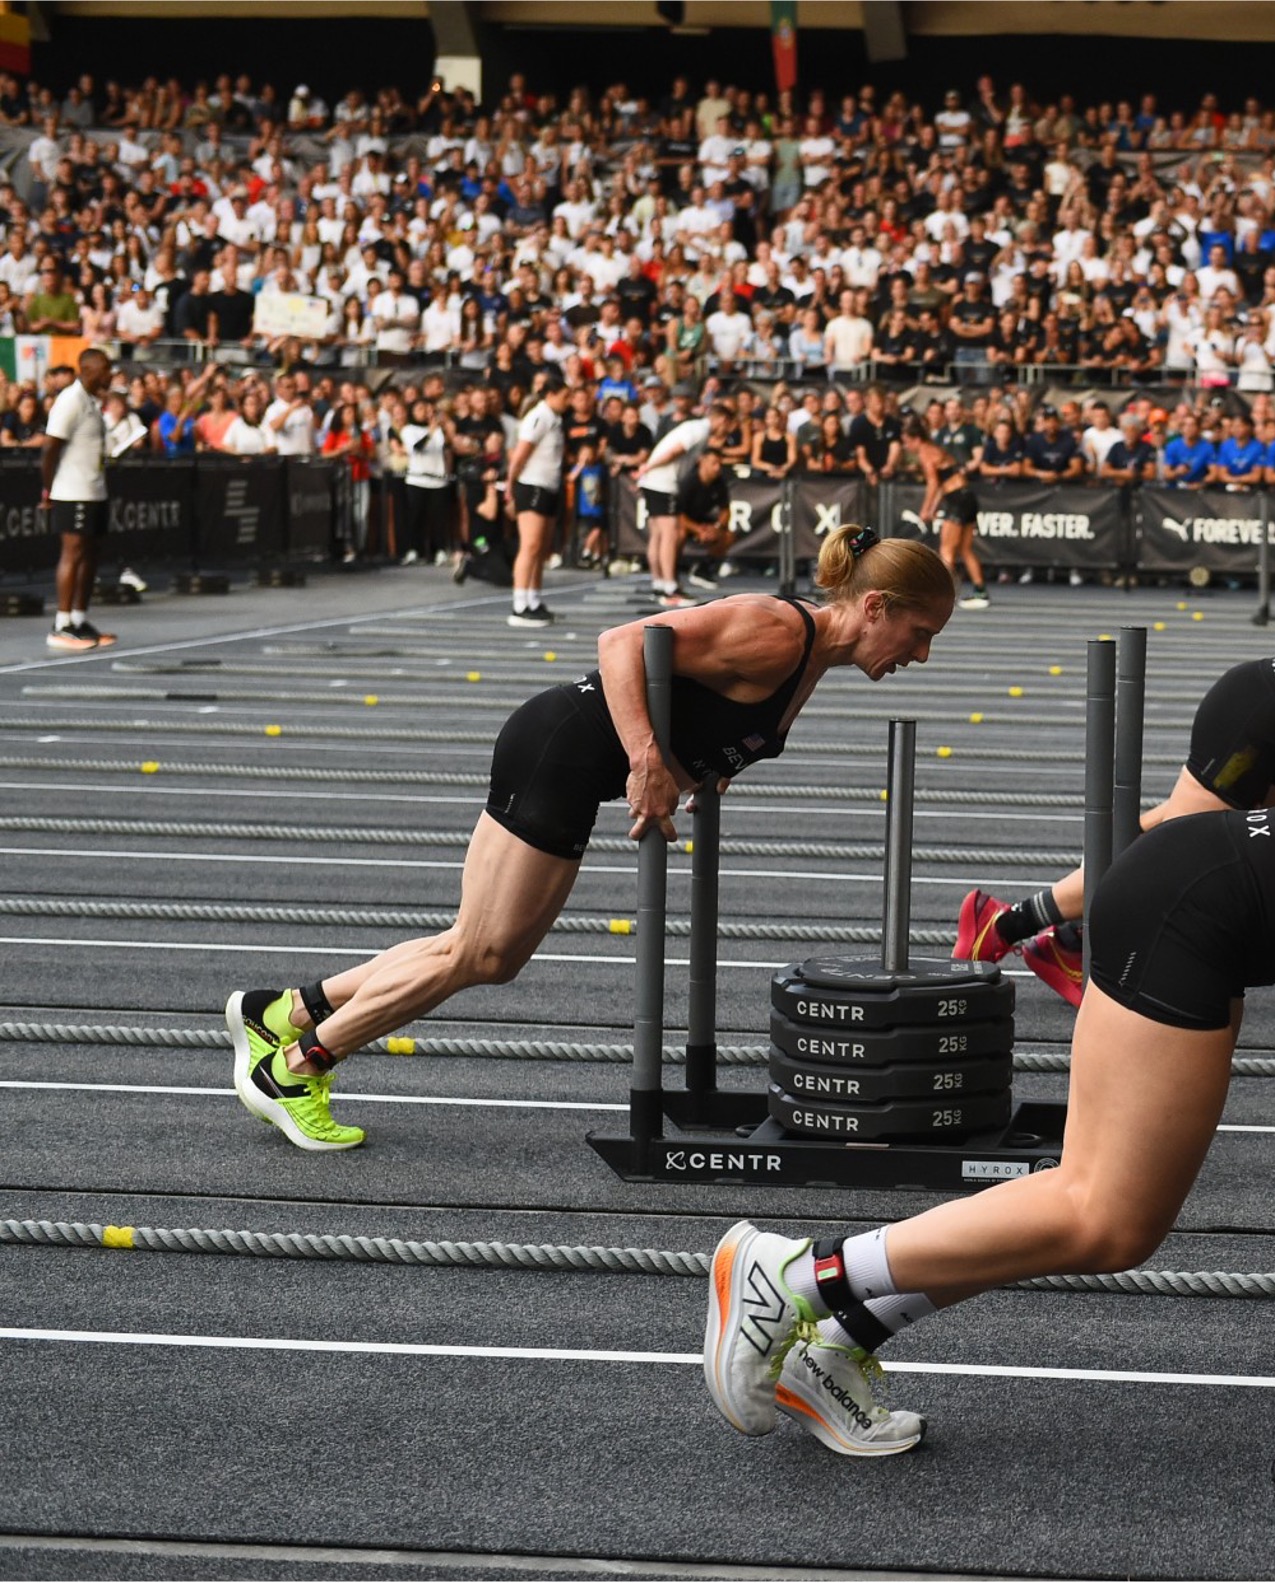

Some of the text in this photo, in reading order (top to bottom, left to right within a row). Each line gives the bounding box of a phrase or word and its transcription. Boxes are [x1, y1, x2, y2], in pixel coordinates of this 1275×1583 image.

[1020, 513, 1096, 539] FASTER.
[796, 1001, 864, 1021] CENTR
[797, 1037, 865, 1059] CENTR
[793, 1074, 860, 1095] CENTR
[792, 1110, 859, 1132] CENTR
[689, 1153, 781, 1171] CENTR
[968, 1165, 1024, 1175] HYROX
[800, 1349, 873, 1430] new balance
